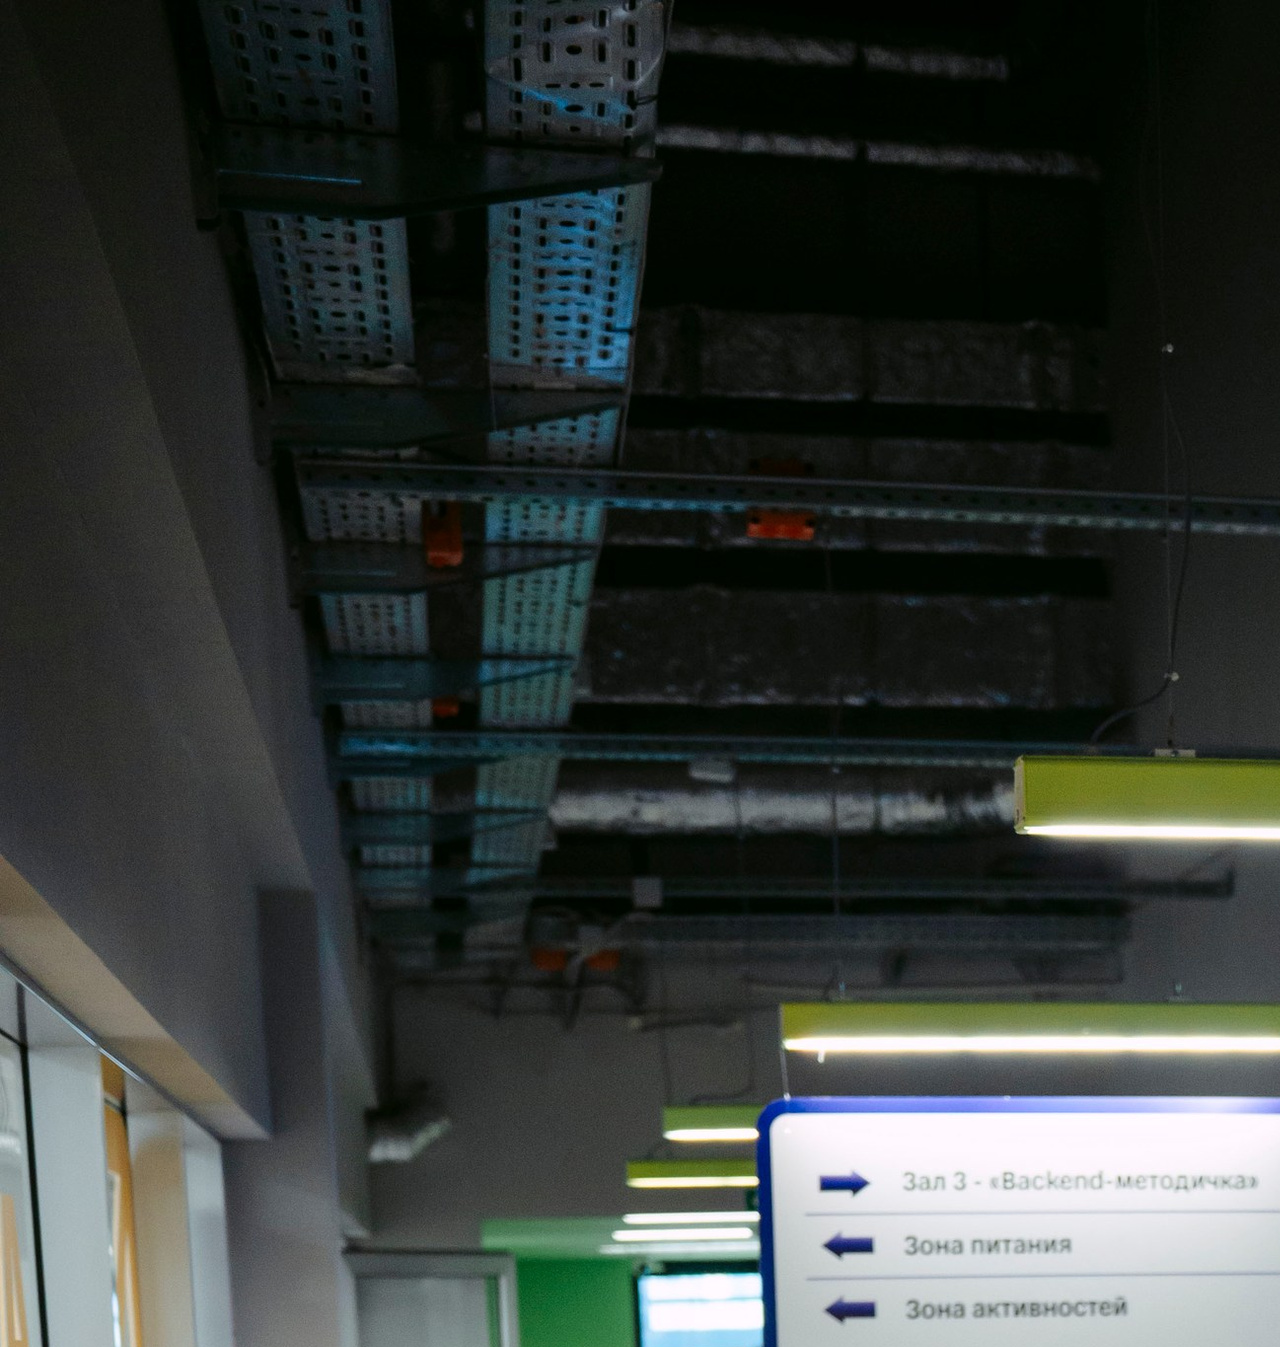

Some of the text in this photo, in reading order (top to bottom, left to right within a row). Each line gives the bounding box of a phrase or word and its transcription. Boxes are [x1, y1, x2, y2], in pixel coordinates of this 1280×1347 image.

[902, 1170, 946, 1192] Зал
[952, 1170, 967, 1191] 3
[989, 1169, 1259, 1194] «Backend-методичка»
[903, 1234, 1072, 1256] Зона питания
[904, 1295, 1129, 1320] Зона активностей
